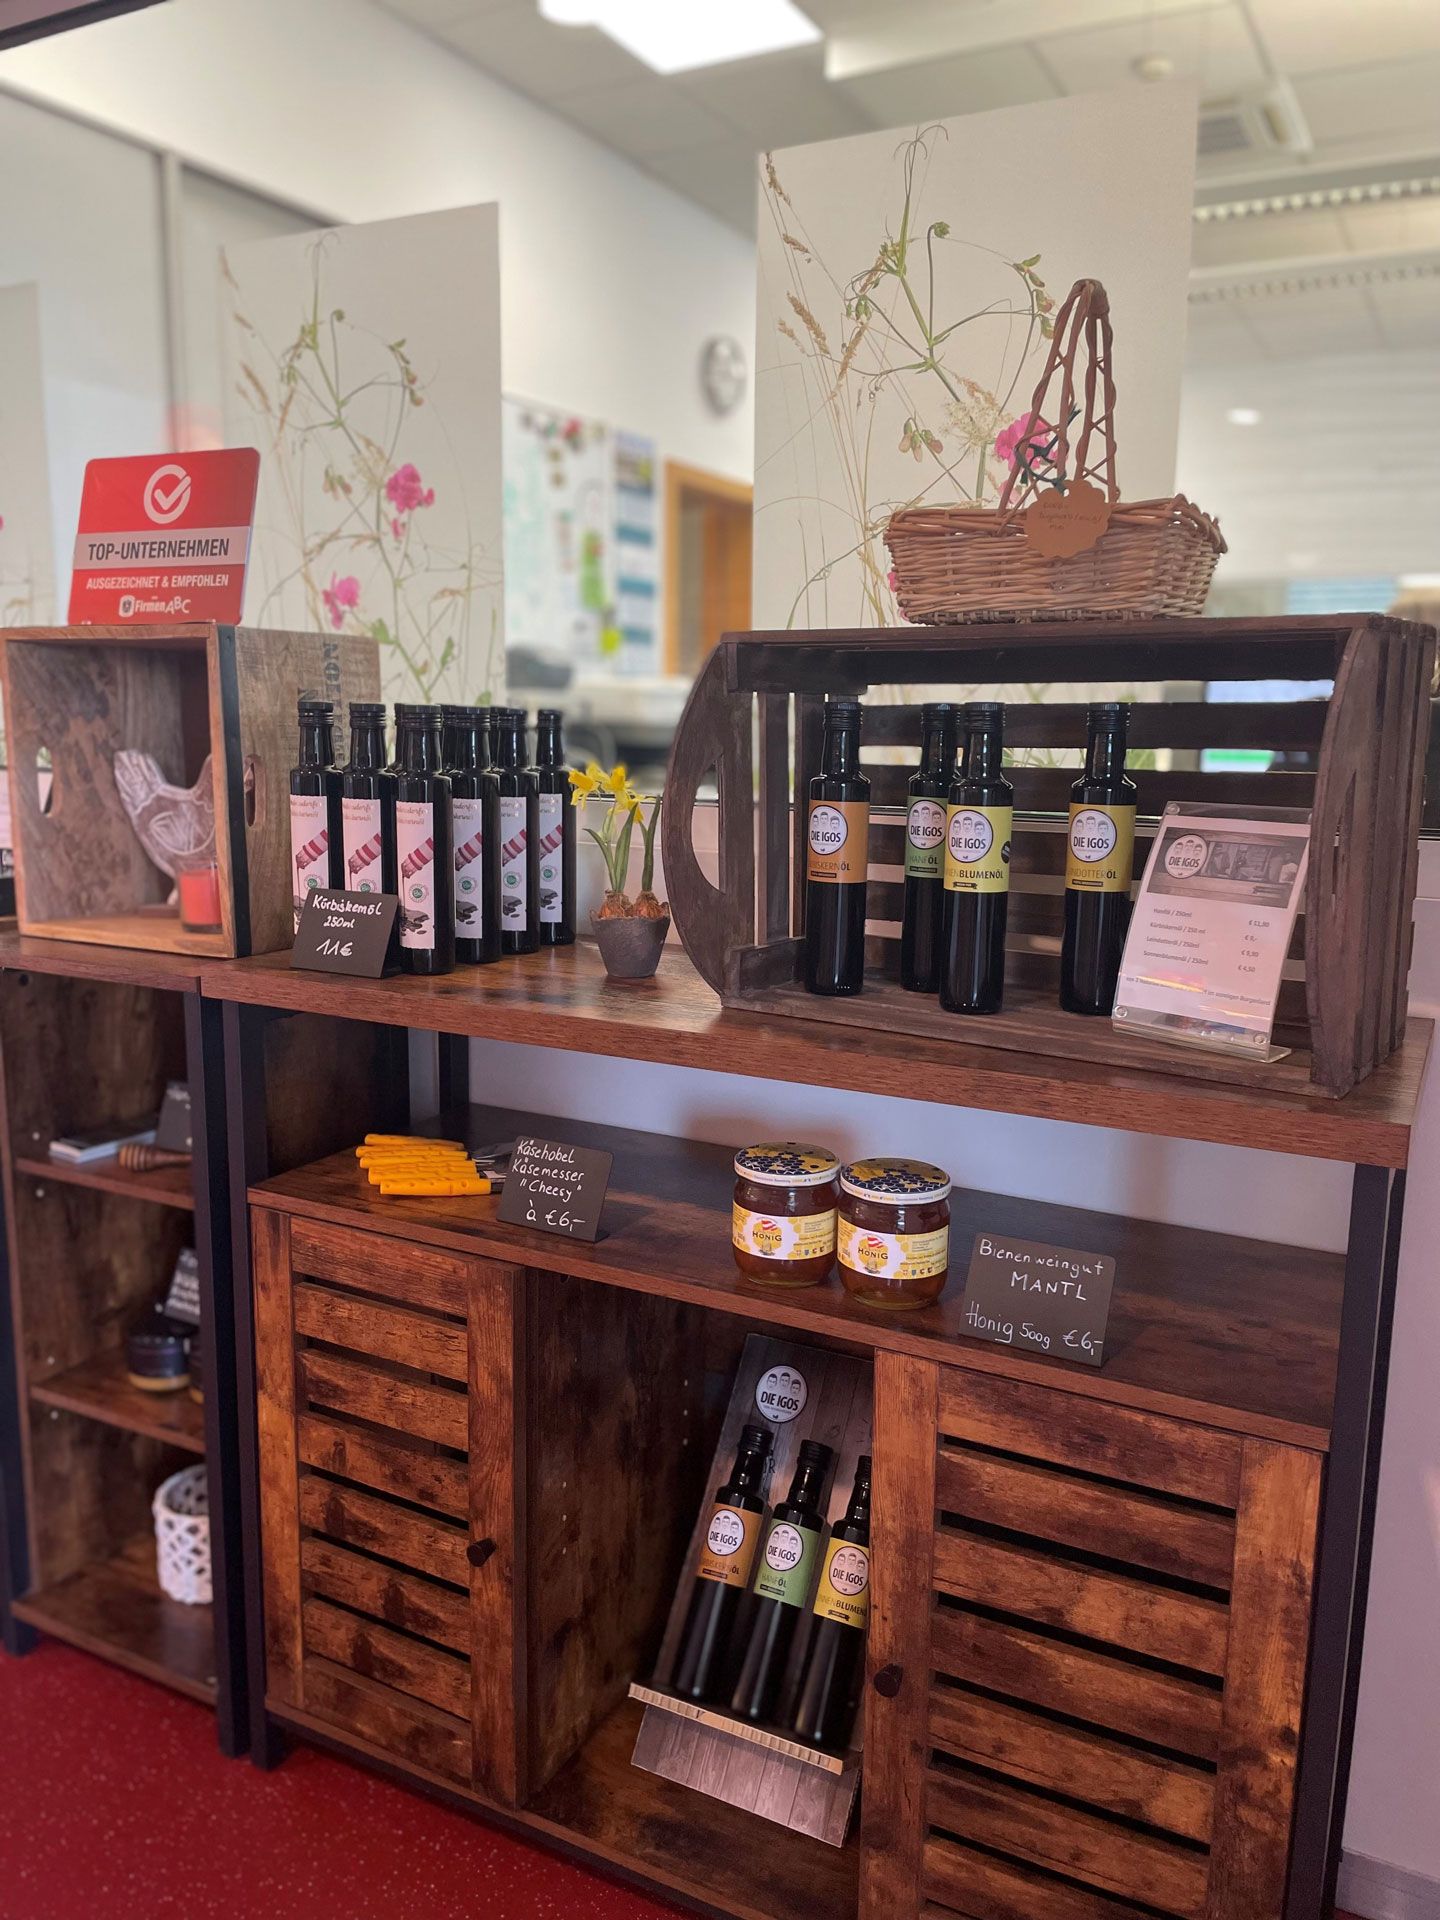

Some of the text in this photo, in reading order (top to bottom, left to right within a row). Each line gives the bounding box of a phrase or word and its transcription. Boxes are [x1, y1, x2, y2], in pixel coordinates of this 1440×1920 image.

[88, 538, 229, 561] TOP-UNTERNEHMEN
[86, 574, 229, 589] AUSGEZEICHNET & EMPFOHLEN
[811, 830, 841, 843] DIE IGOS
[911, 825, 942, 837] DIE IGOS
[951, 837, 986, 849] DIE IGOS
[1073, 837, 1109, 849] DIE IGOS
[1168, 856, 1200, 868] DIE IGOS
[323, 915, 356, 928] 250ml
[316, 938, 353, 957] 11€
[517, 1139, 575, 1164] Käsehobel
[512, 1157, 584, 1182] Käsemesser
[753, 1231, 782, 1241] HONIG
[858, 1248, 888, 1260] HONIG
[1010, 1271, 1087, 1300] MANTL
[966, 1301, 1013, 1343] Honig
[1019, 1322, 1050, 1349] 500g
[760, 1391, 776, 1406] DIE
[777, 1395, 799, 1411] IGOS
[709, 1531, 738, 1546] DIE IGOS
[768, 1545, 796, 1562] DIE IGOS
[833, 1568, 864, 1586] DIE IGOS
